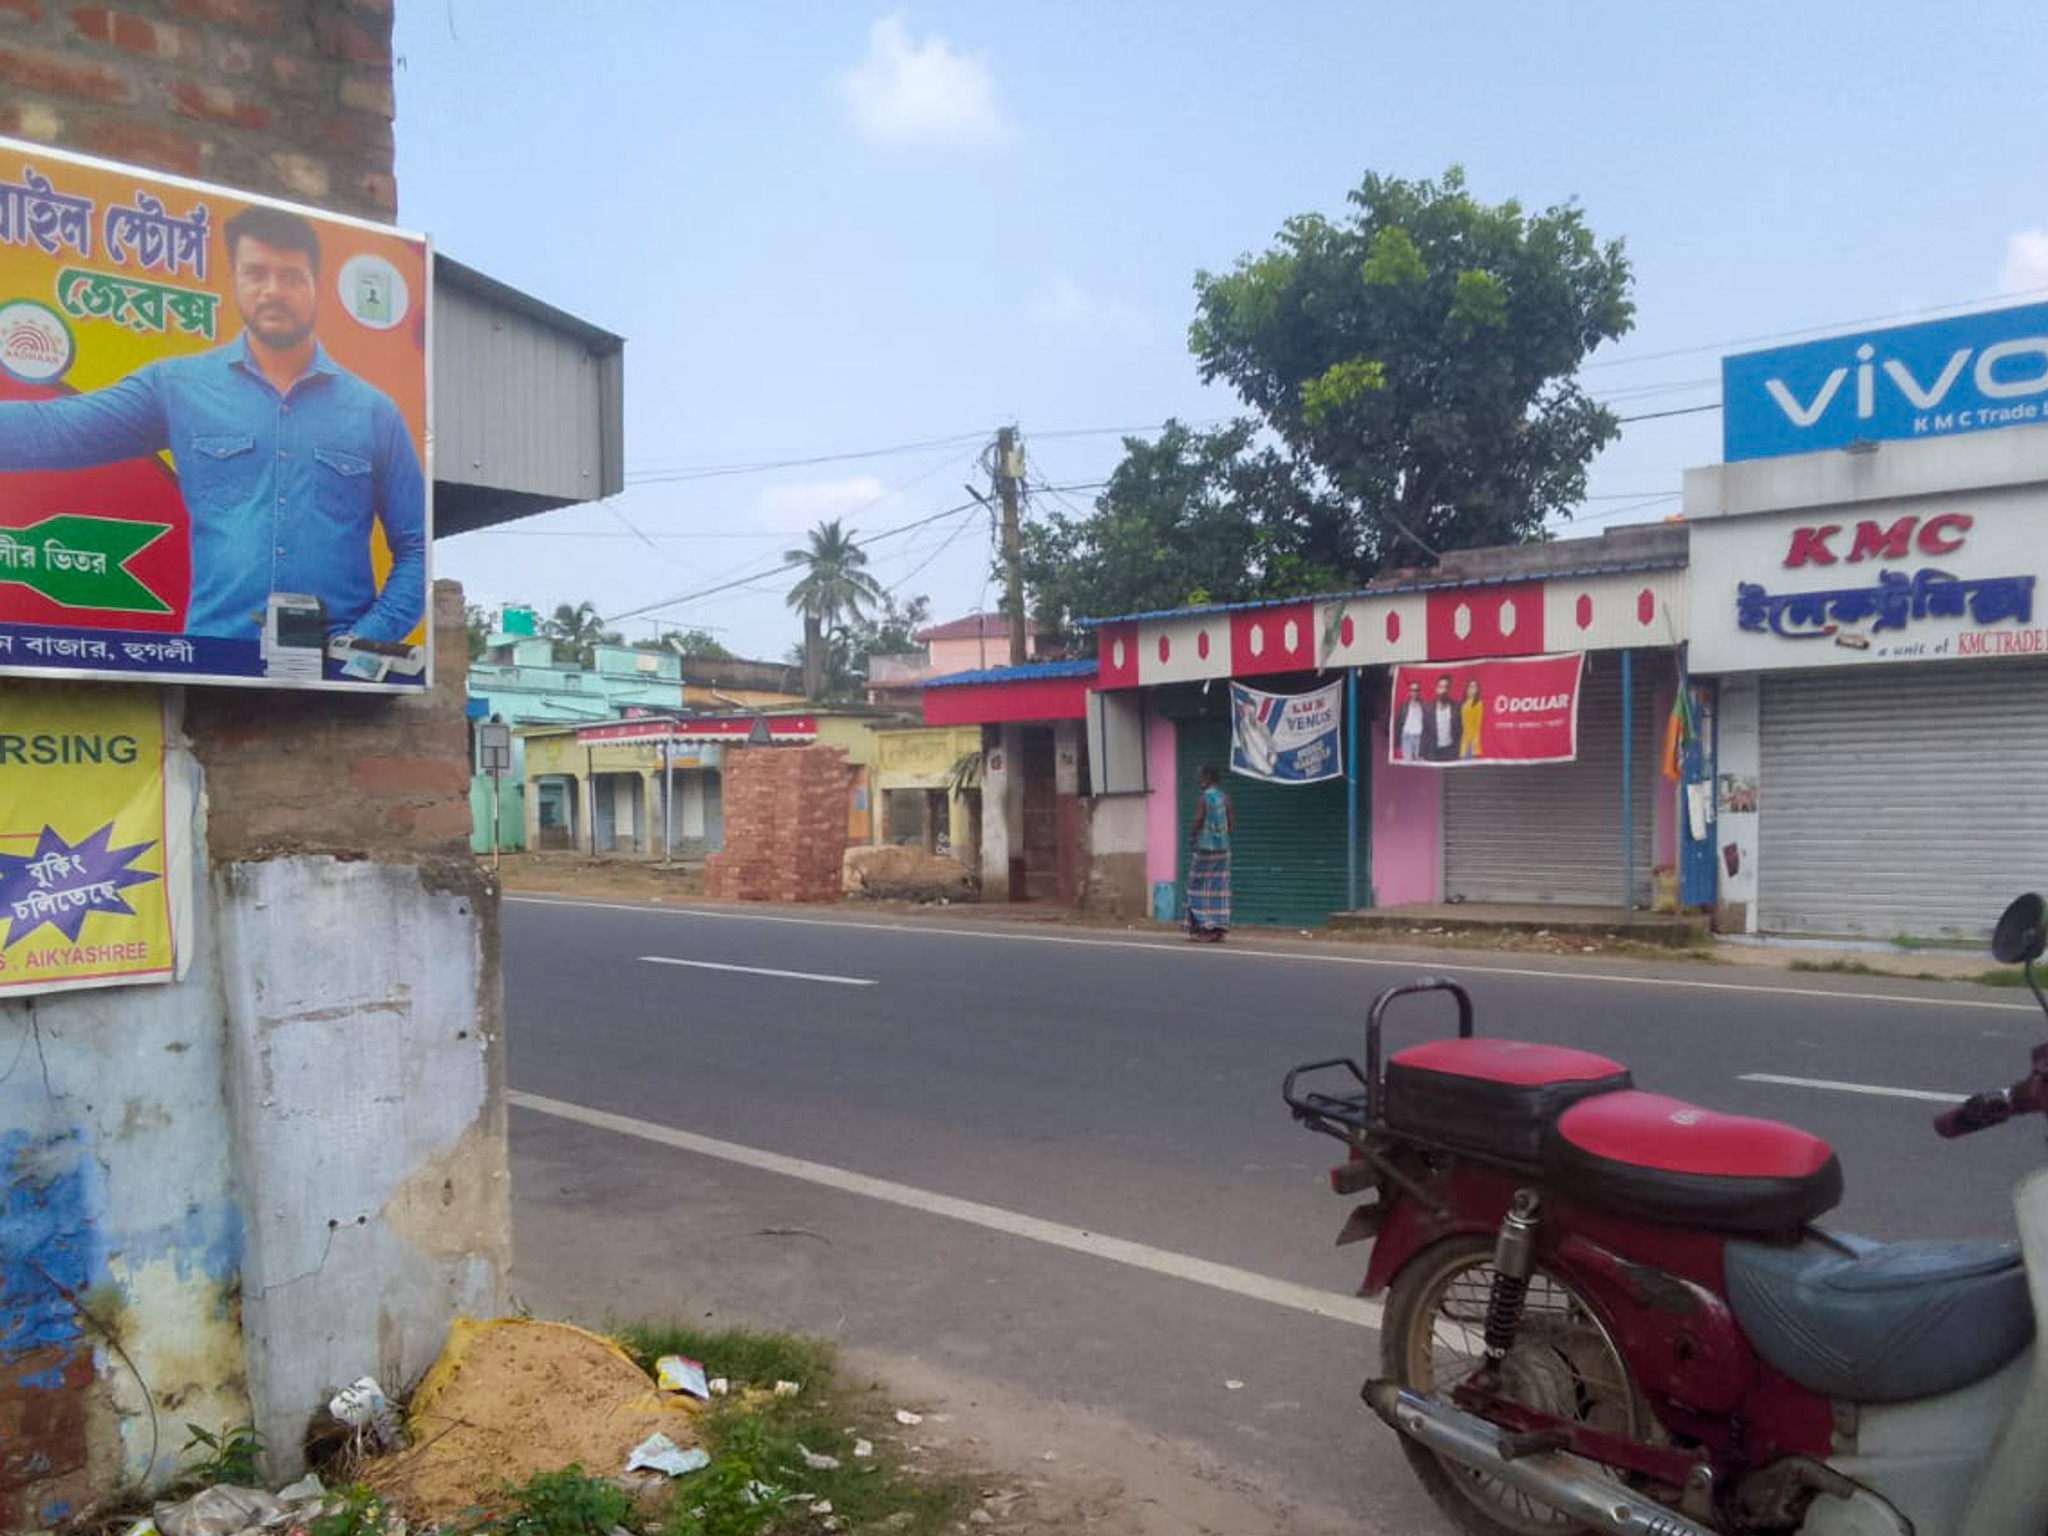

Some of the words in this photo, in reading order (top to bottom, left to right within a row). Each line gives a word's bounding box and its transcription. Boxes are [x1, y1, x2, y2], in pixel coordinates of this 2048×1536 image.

[105, 190, 208, 280] স্টোর্স
[57, 268, 219, 338] জেরক্স
[1765, 343, 2048, 427] vivo
[1977, 403, 2037, 423] Trade
[43, 538, 106, 575] ভিতর
[1783, 513, 1974, 568] KMC
[121, 639, 195, 663] হুগলী
[1286, 709, 1331, 731] VENUS
[1292, 697, 1325, 713] LUX
[1509, 694, 1569, 713] DOLLAR
[25, 852, 87, 888] বুকিং
[11, 880, 120, 920] চলিতেছে
[25, 942, 147, 968] AIKYASHREE
